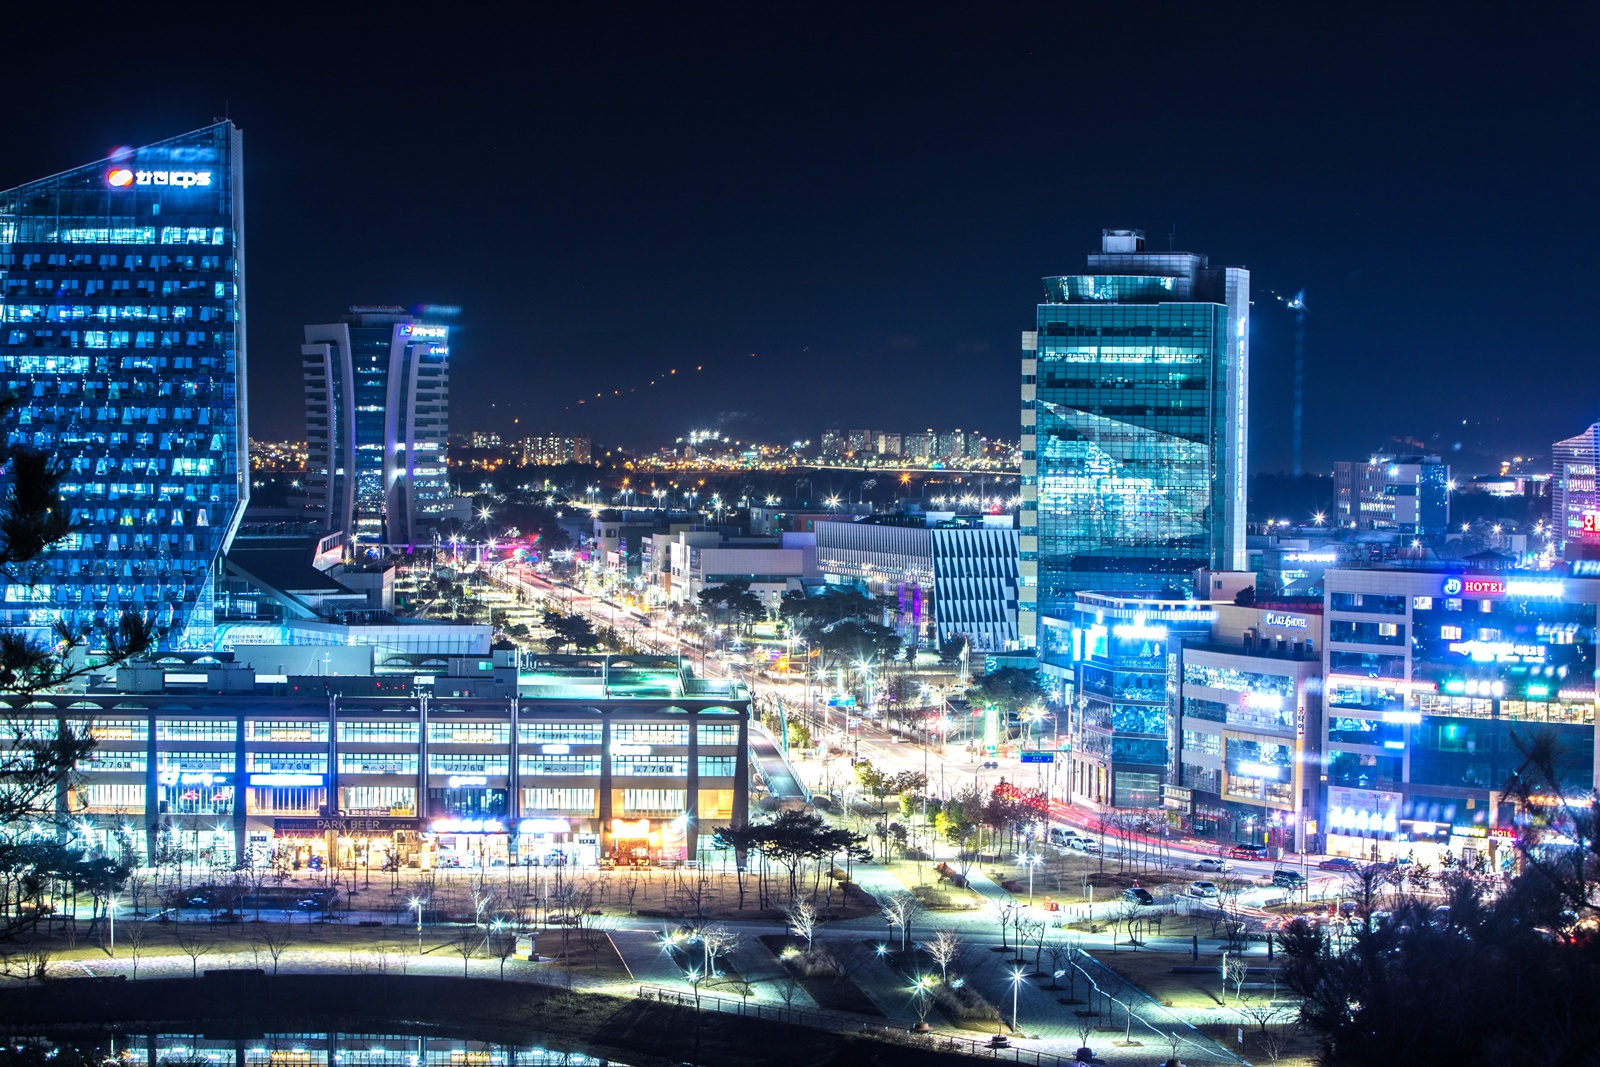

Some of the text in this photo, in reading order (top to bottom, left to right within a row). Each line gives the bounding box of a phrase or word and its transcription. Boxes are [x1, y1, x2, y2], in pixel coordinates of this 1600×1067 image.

[1465, 581, 1506, 593] HOTEL
[1297, 706, 1305, 731] 궁타이
[316, 820, 346, 829] PARK
[350, 820, 380, 829] BEER
